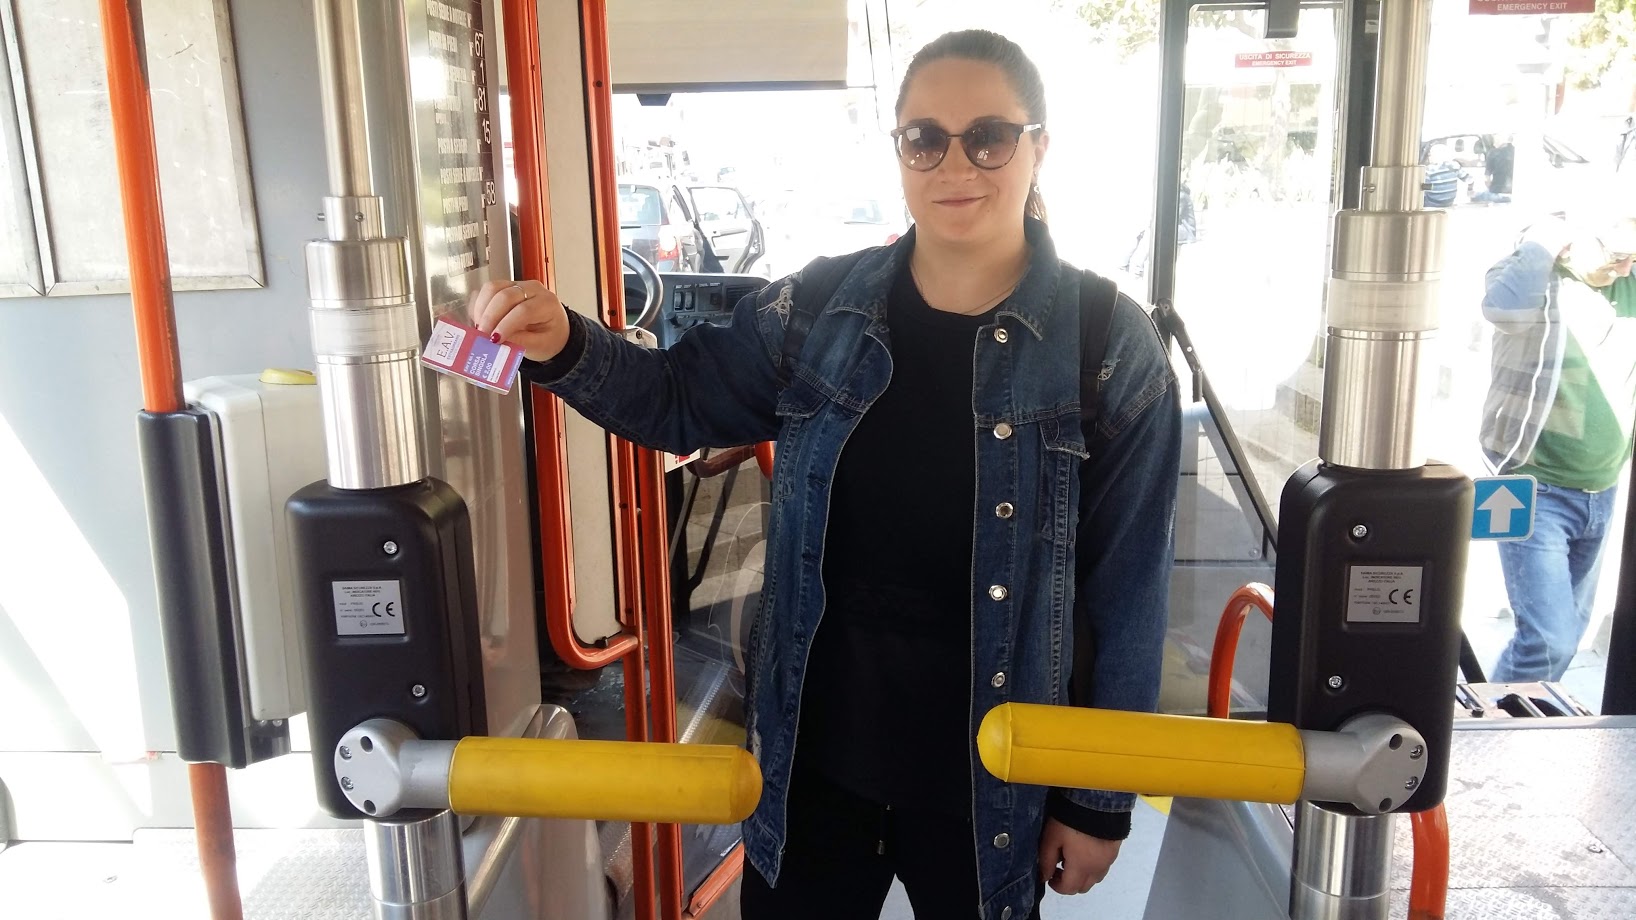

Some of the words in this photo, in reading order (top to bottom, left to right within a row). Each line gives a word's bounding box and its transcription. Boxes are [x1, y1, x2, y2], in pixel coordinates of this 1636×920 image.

[1497, 3, 1548, 11] EMERGENCY
[1550, 2, 1568, 10] EXIT
[474, 31, 484, 57] 67
[1275, 52, 1311, 60] SICUREZZA
[480, 60, 485, 84] 1
[477, 87, 487, 111] 81
[482, 118, 491, 144] 15
[486, 181, 496, 205] 58
[470, 356, 482, 375] CORSA
[474, 353, 489, 377] SINGOLA
